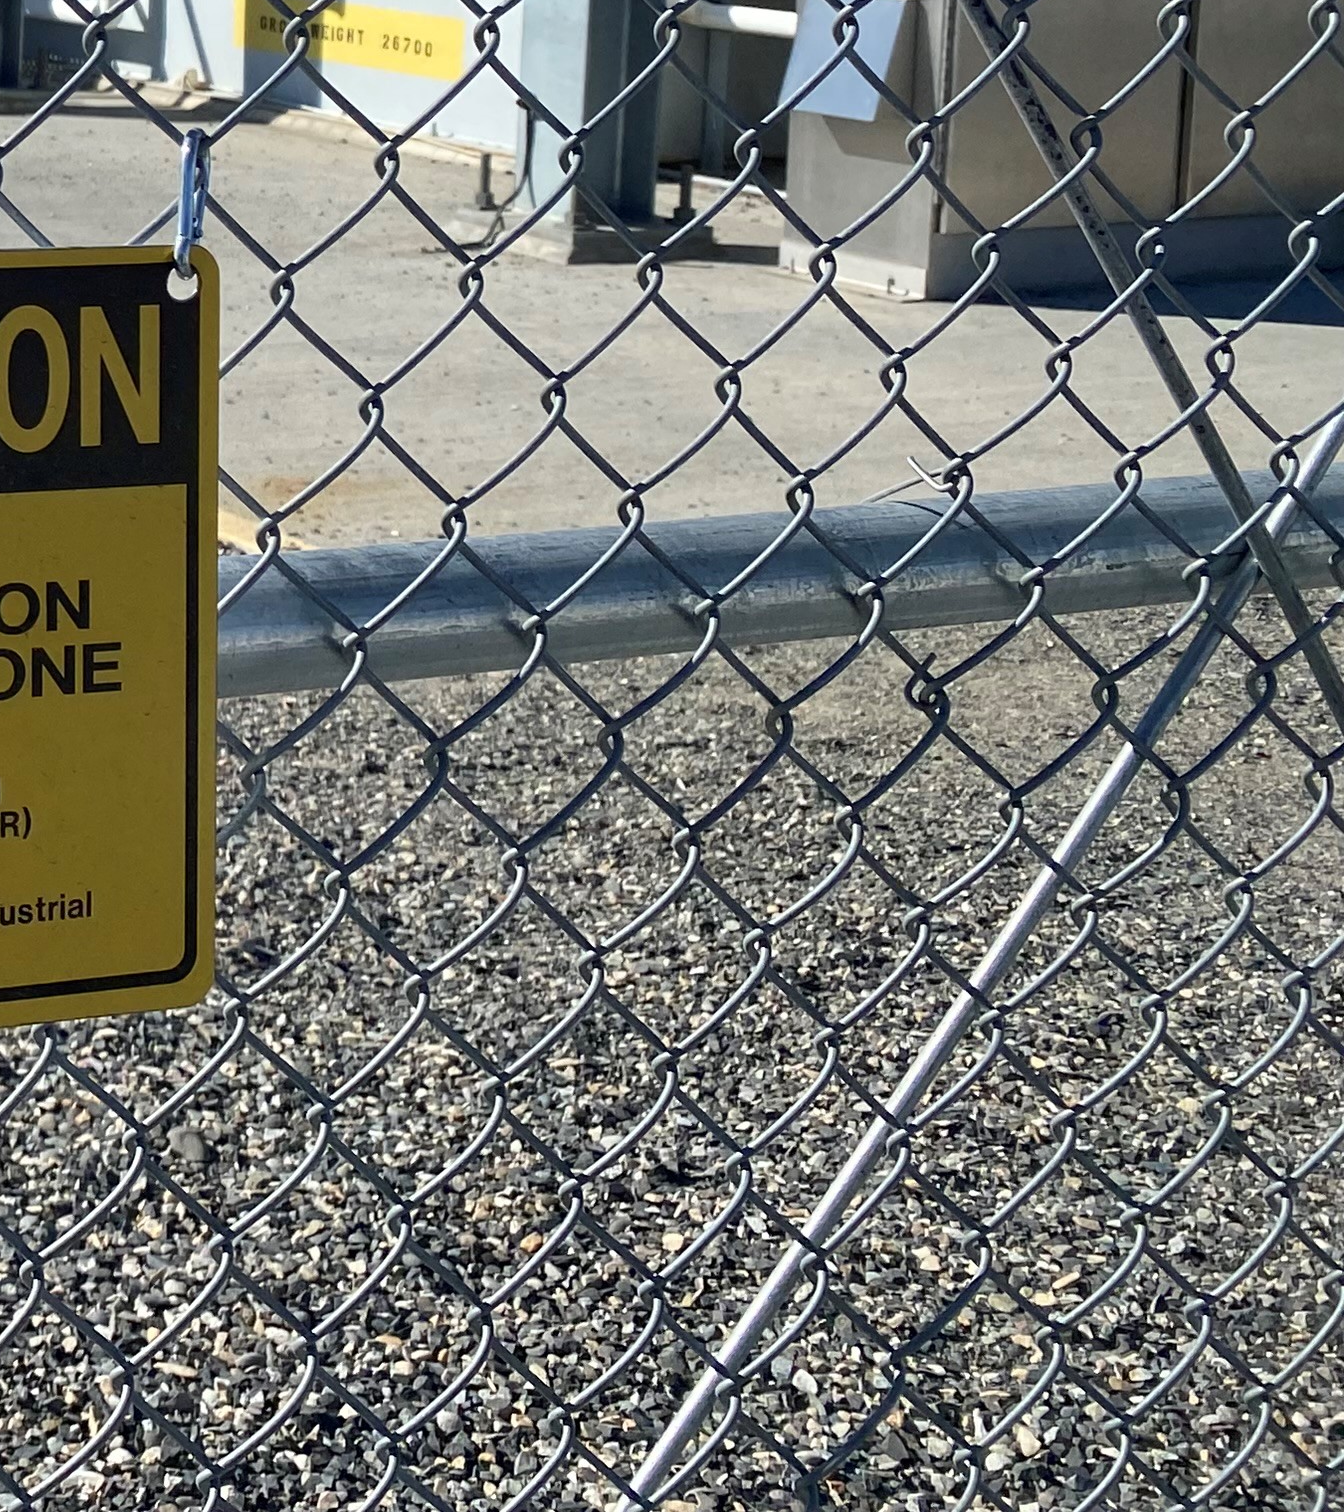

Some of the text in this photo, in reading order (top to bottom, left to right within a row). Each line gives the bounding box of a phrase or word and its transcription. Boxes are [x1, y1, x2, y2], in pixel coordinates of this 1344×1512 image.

[259, 15, 434, 57] GRO WEIGHT 26700
